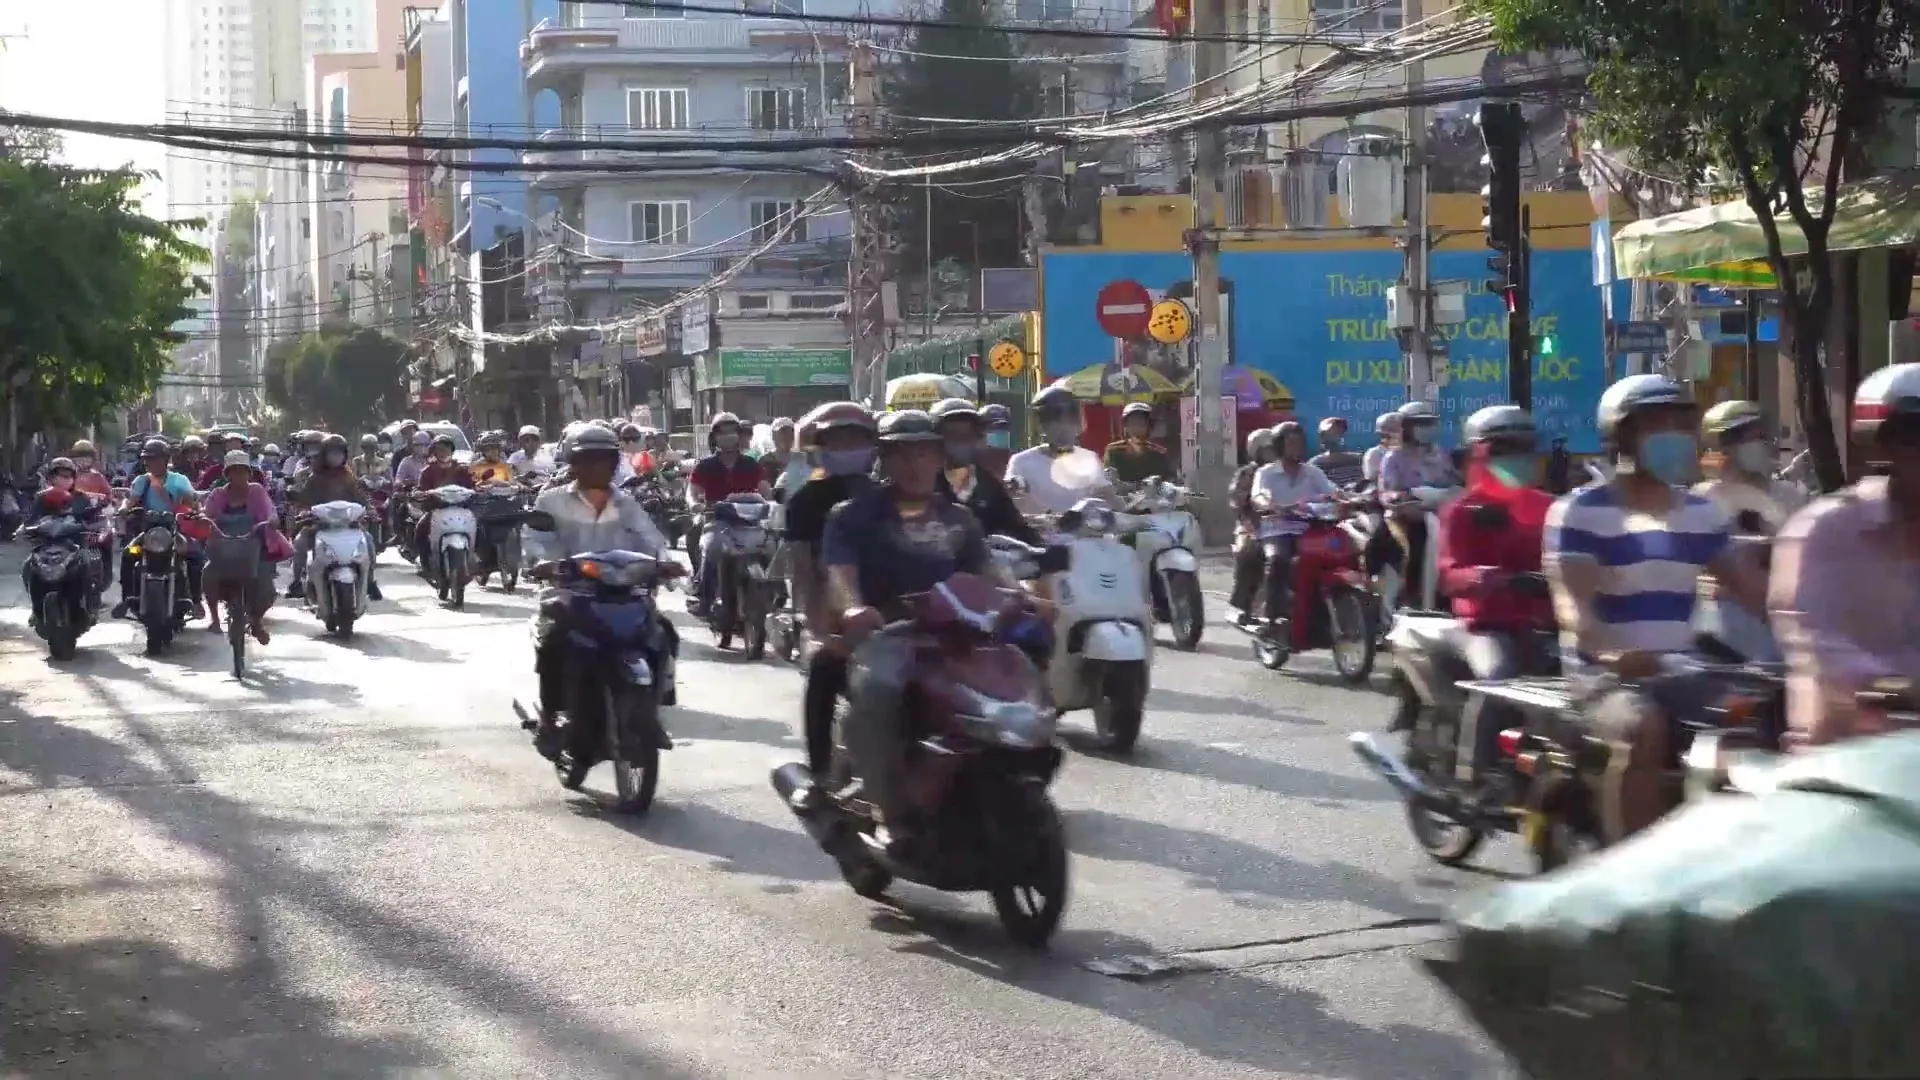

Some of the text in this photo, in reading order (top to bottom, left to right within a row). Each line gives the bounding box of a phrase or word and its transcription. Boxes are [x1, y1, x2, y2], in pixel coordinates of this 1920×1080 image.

[1326, 273, 1397, 298] Thán
[1326, 312, 1392, 342] TRÚ
[1326, 360, 1362, 384] DU
